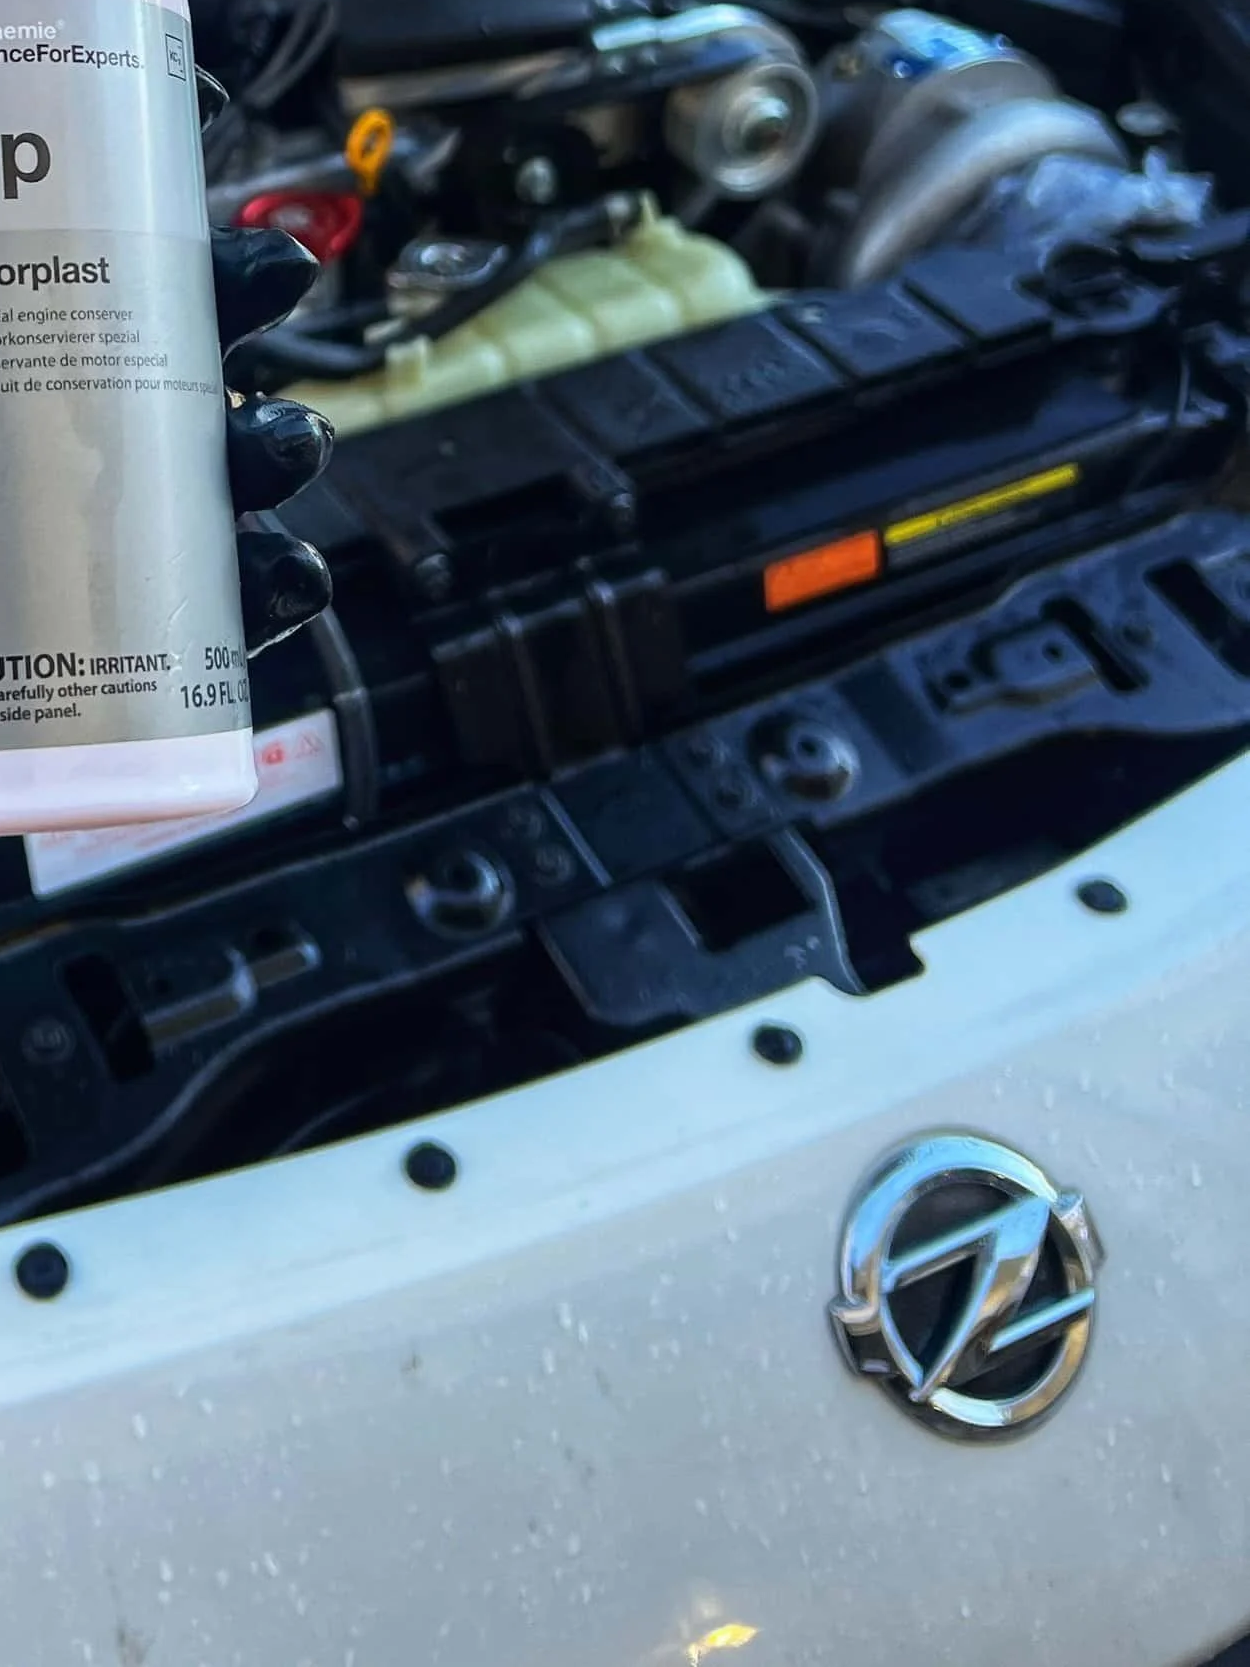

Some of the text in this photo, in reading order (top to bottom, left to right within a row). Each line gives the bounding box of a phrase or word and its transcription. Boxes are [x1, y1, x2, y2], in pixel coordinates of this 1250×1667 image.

[17, 308, 68, 324] engine
[70, 310, 134, 321] conserver
[99, 330, 140, 346] spezial
[59, 353, 78, 367] de
[81, 356, 121, 367] motor
[124, 353, 168, 368] especial
[23, 377, 43, 392] de
[45, 377, 133, 392] conservation
[134, 378, 161, 394] pour
[89, 653, 171, 676] IRRITANT.
[205, 646, 230, 670] 500
[57, 682, 97, 698] other
[100, 679, 158, 695] cautions
[180, 683, 217, 709] 16.9
[0, 705, 32, 722] side
[34, 702, 82, 723] panel.
